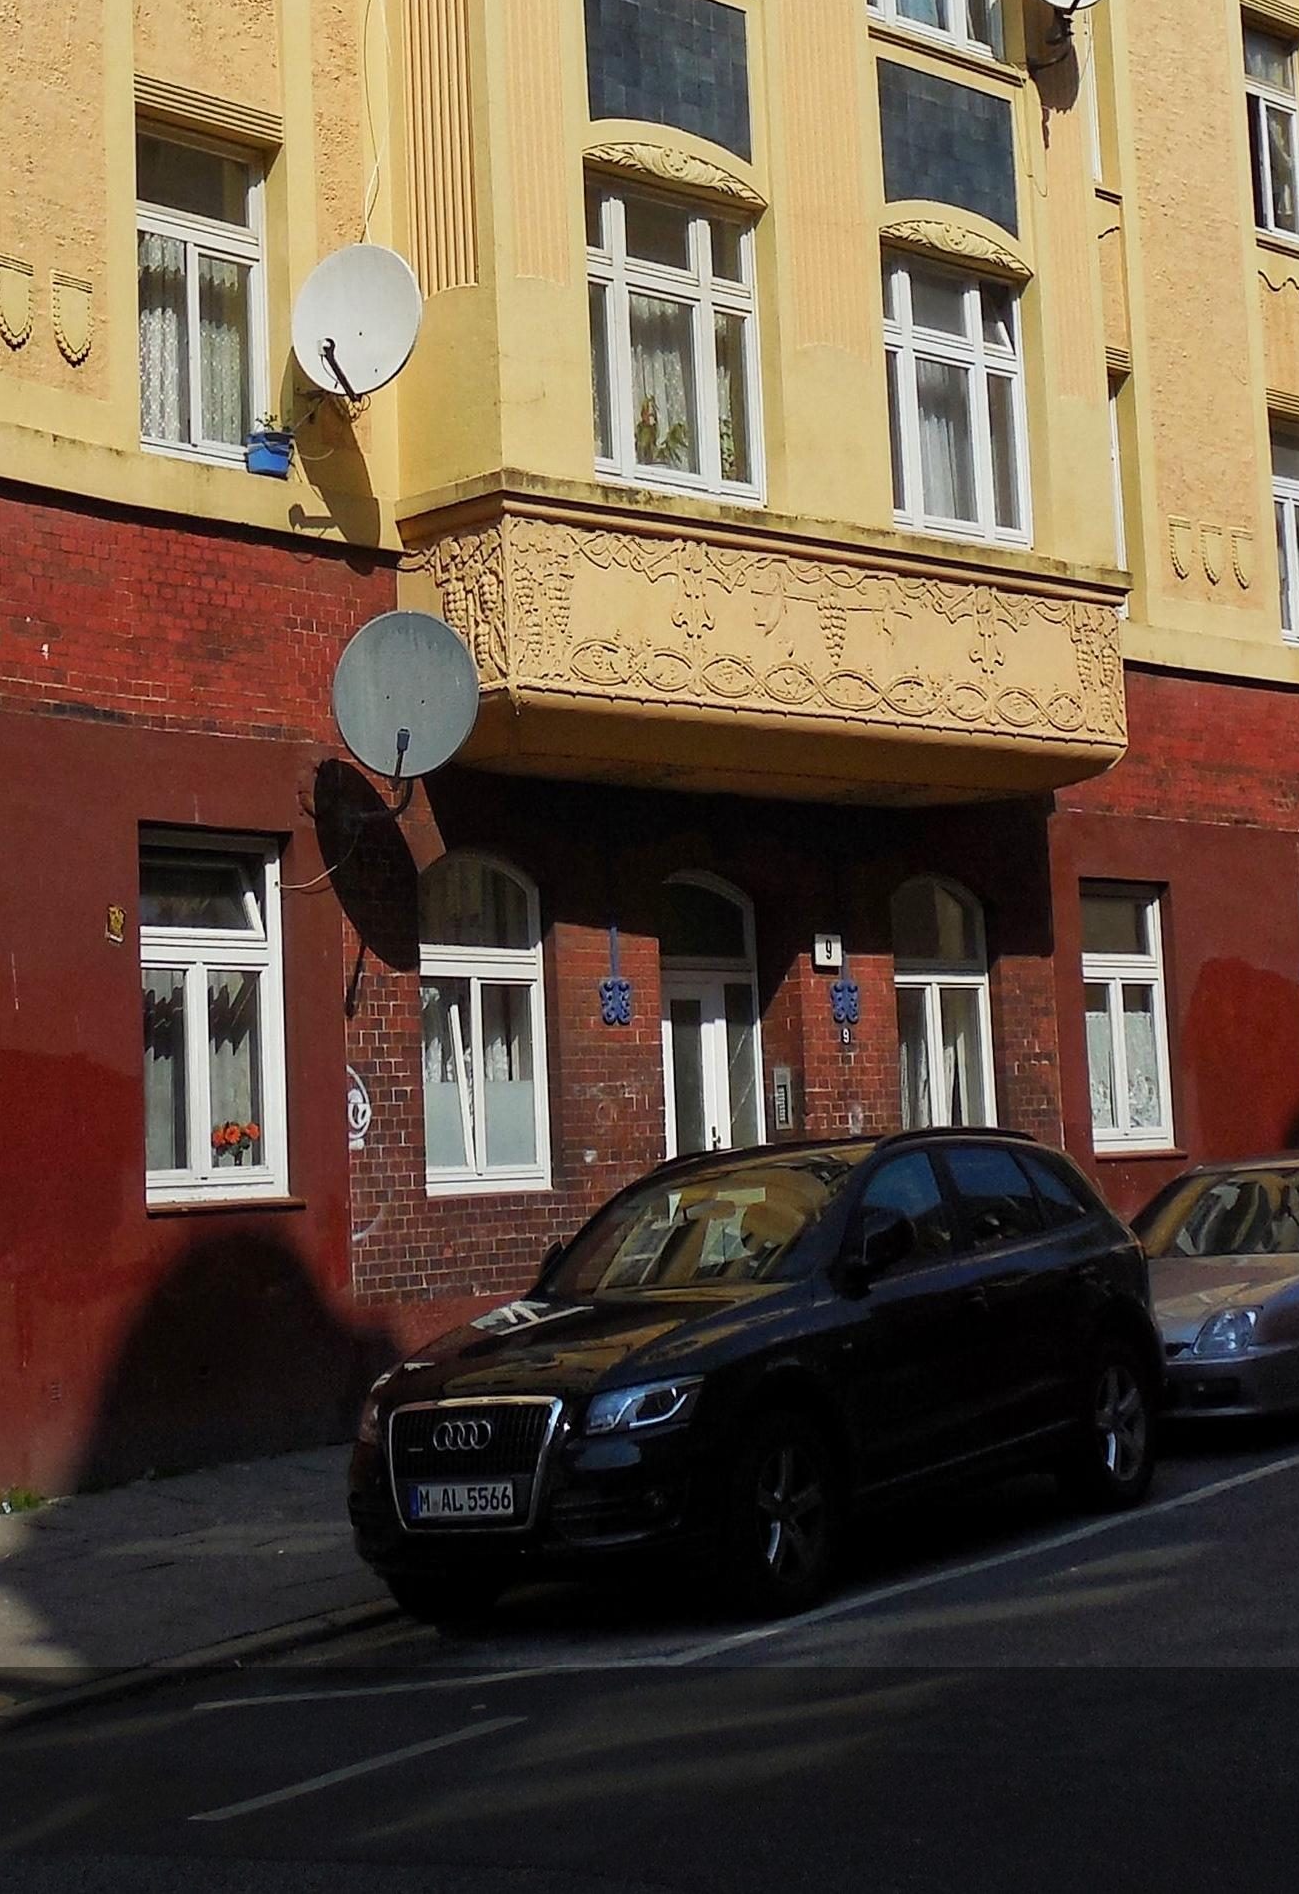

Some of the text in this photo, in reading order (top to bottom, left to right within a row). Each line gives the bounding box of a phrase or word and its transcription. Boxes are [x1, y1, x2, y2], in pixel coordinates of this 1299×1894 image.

[825, 939, 833, 960] 9
[842, 1028, 850, 1043] 9
[467, 1487, 512, 1512] 5566
